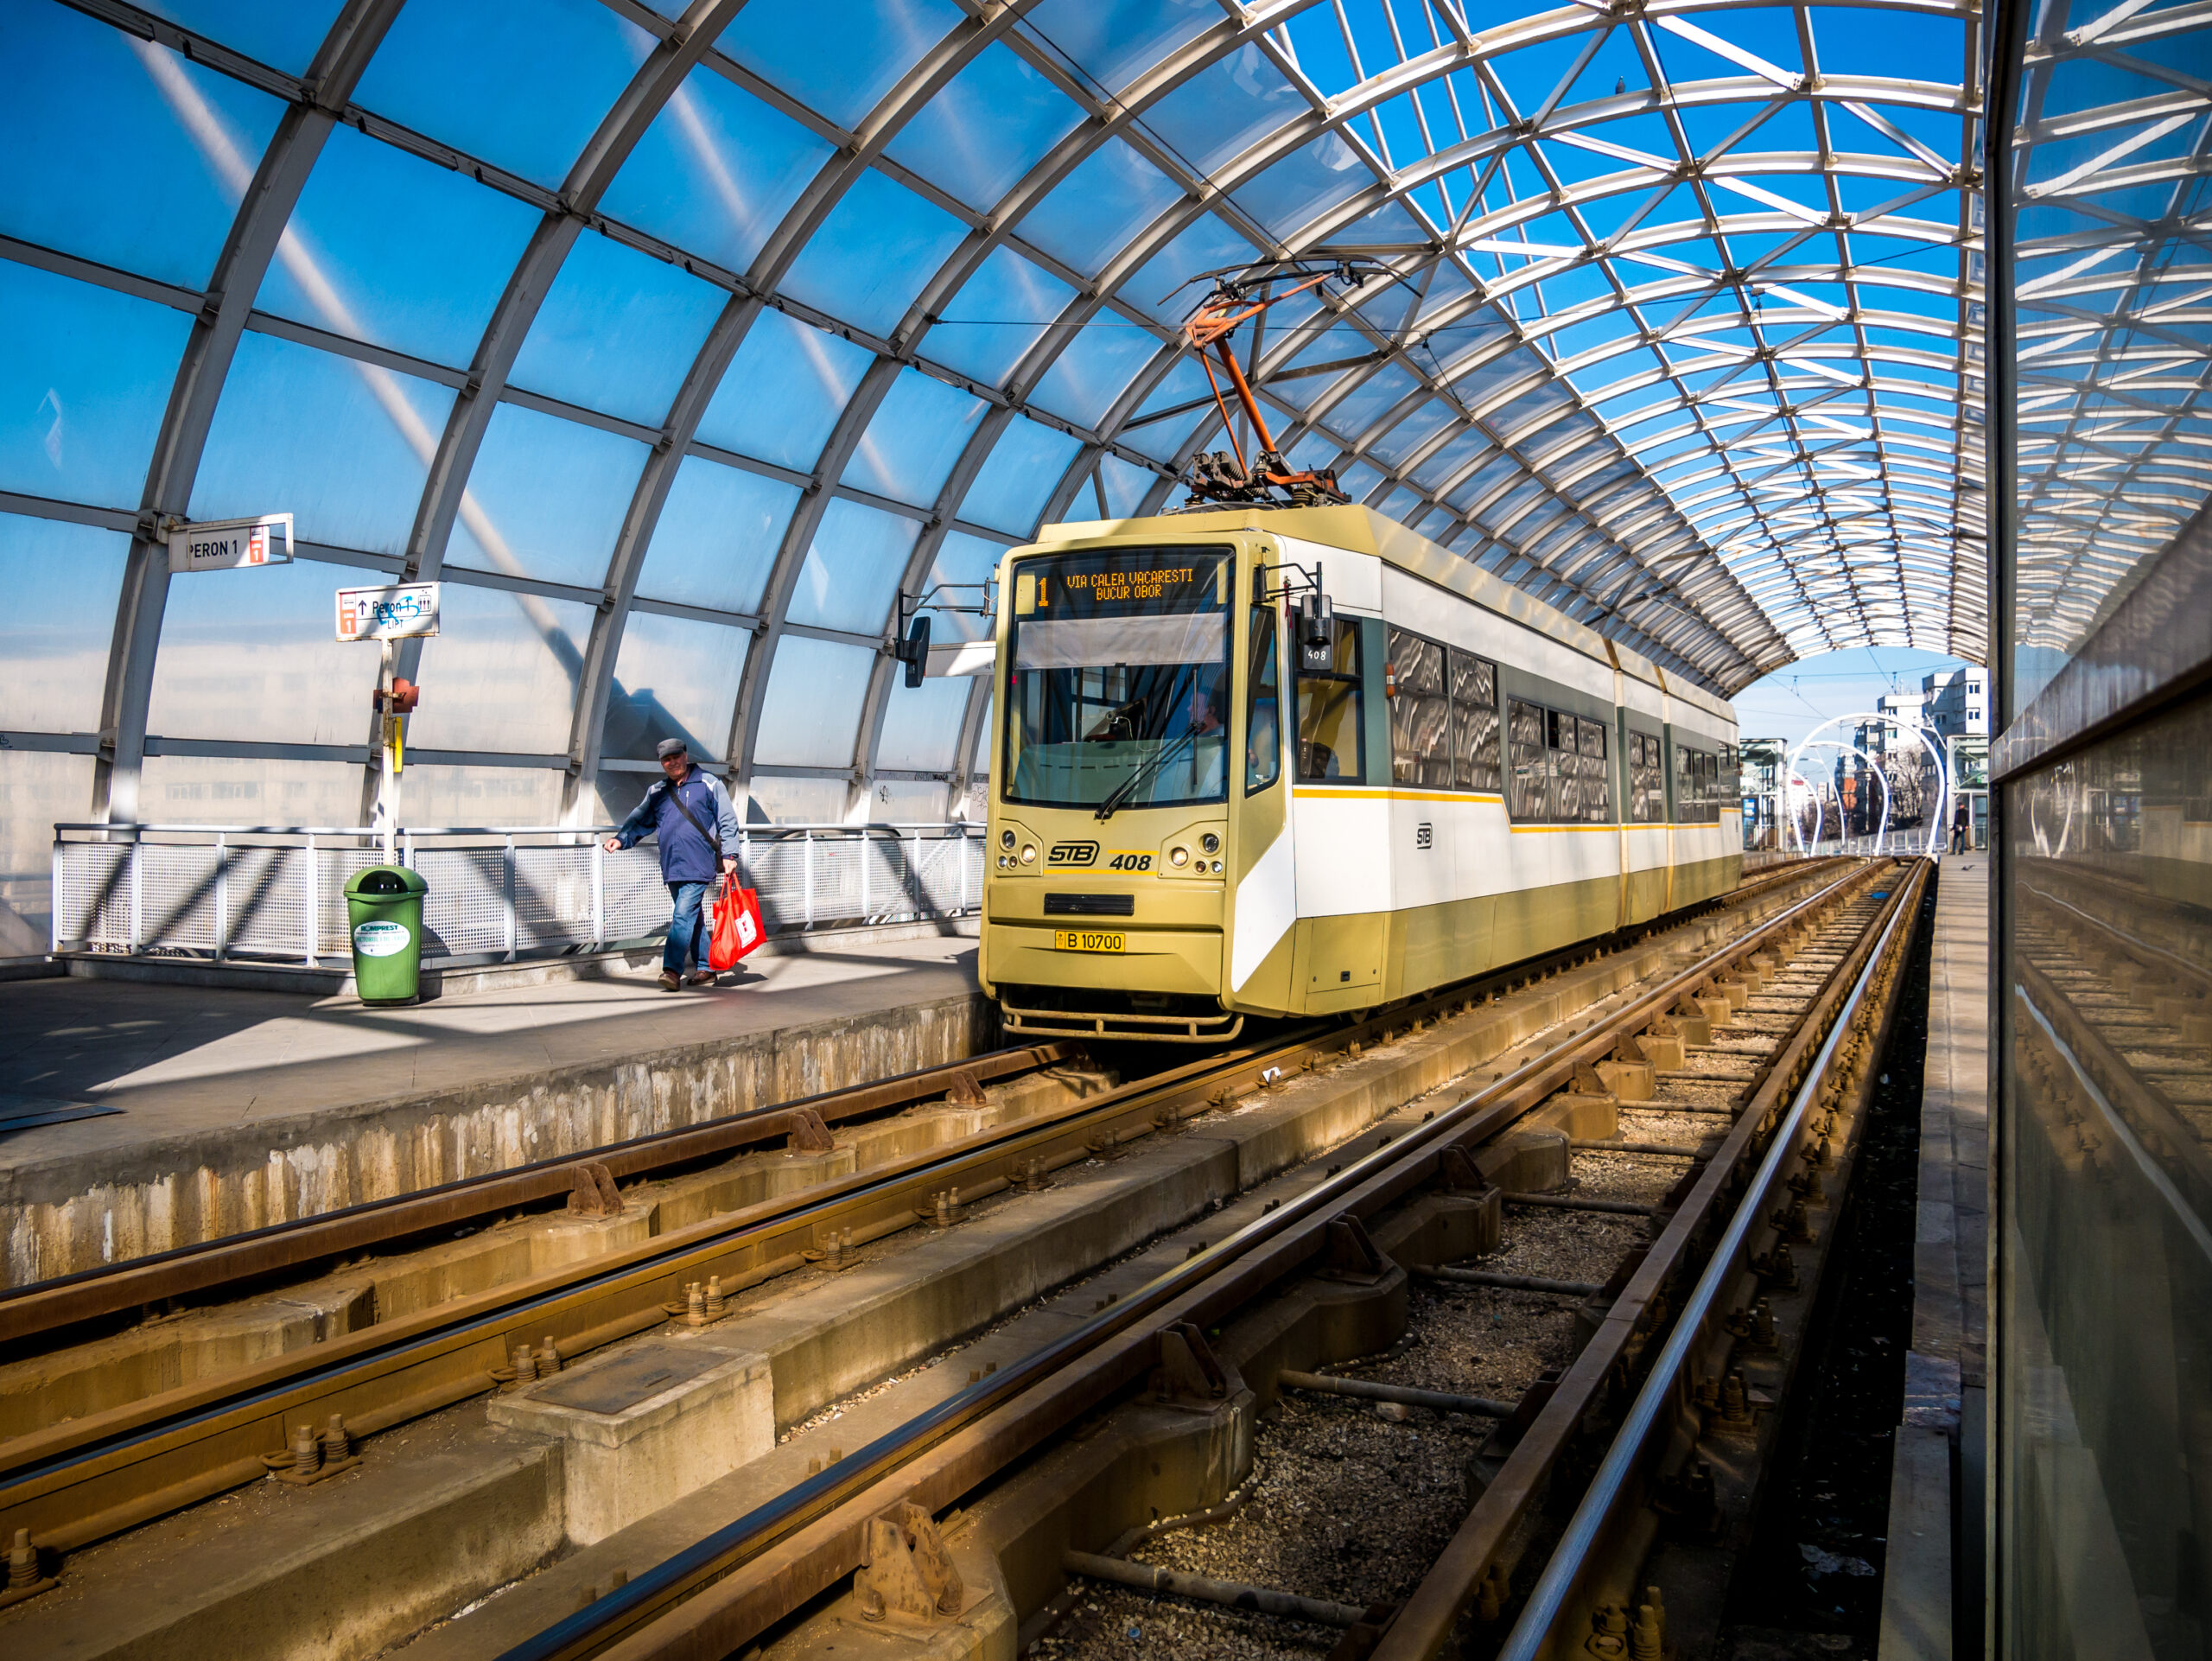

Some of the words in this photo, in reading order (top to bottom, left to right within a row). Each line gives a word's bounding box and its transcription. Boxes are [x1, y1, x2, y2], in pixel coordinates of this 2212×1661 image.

[186, 540, 228, 559] PERON
[232, 539, 238, 554] 1
[253, 550, 258, 561] 1
[1066, 576, 1087, 589] VIA
[1091, 573, 1125, 588] CALEA
[1128, 568, 1193, 585] VACARESTI
[1038, 577, 1049, 607] 1
[1096, 586, 1131, 601] BUCUR
[1134, 584, 1162, 599] OBOR
[372, 601, 402, 614] Peron
[405, 598, 410, 612] 1
[346, 620, 352, 633] 1
[1307, 650, 1326, 661] 408
[1417, 827, 1431, 845] STB
[1047, 844, 1095, 862] STB
[1109, 854, 1152, 871] 408
[1067, 933, 1077, 948] B
[1082, 933, 1122, 950] 10700
